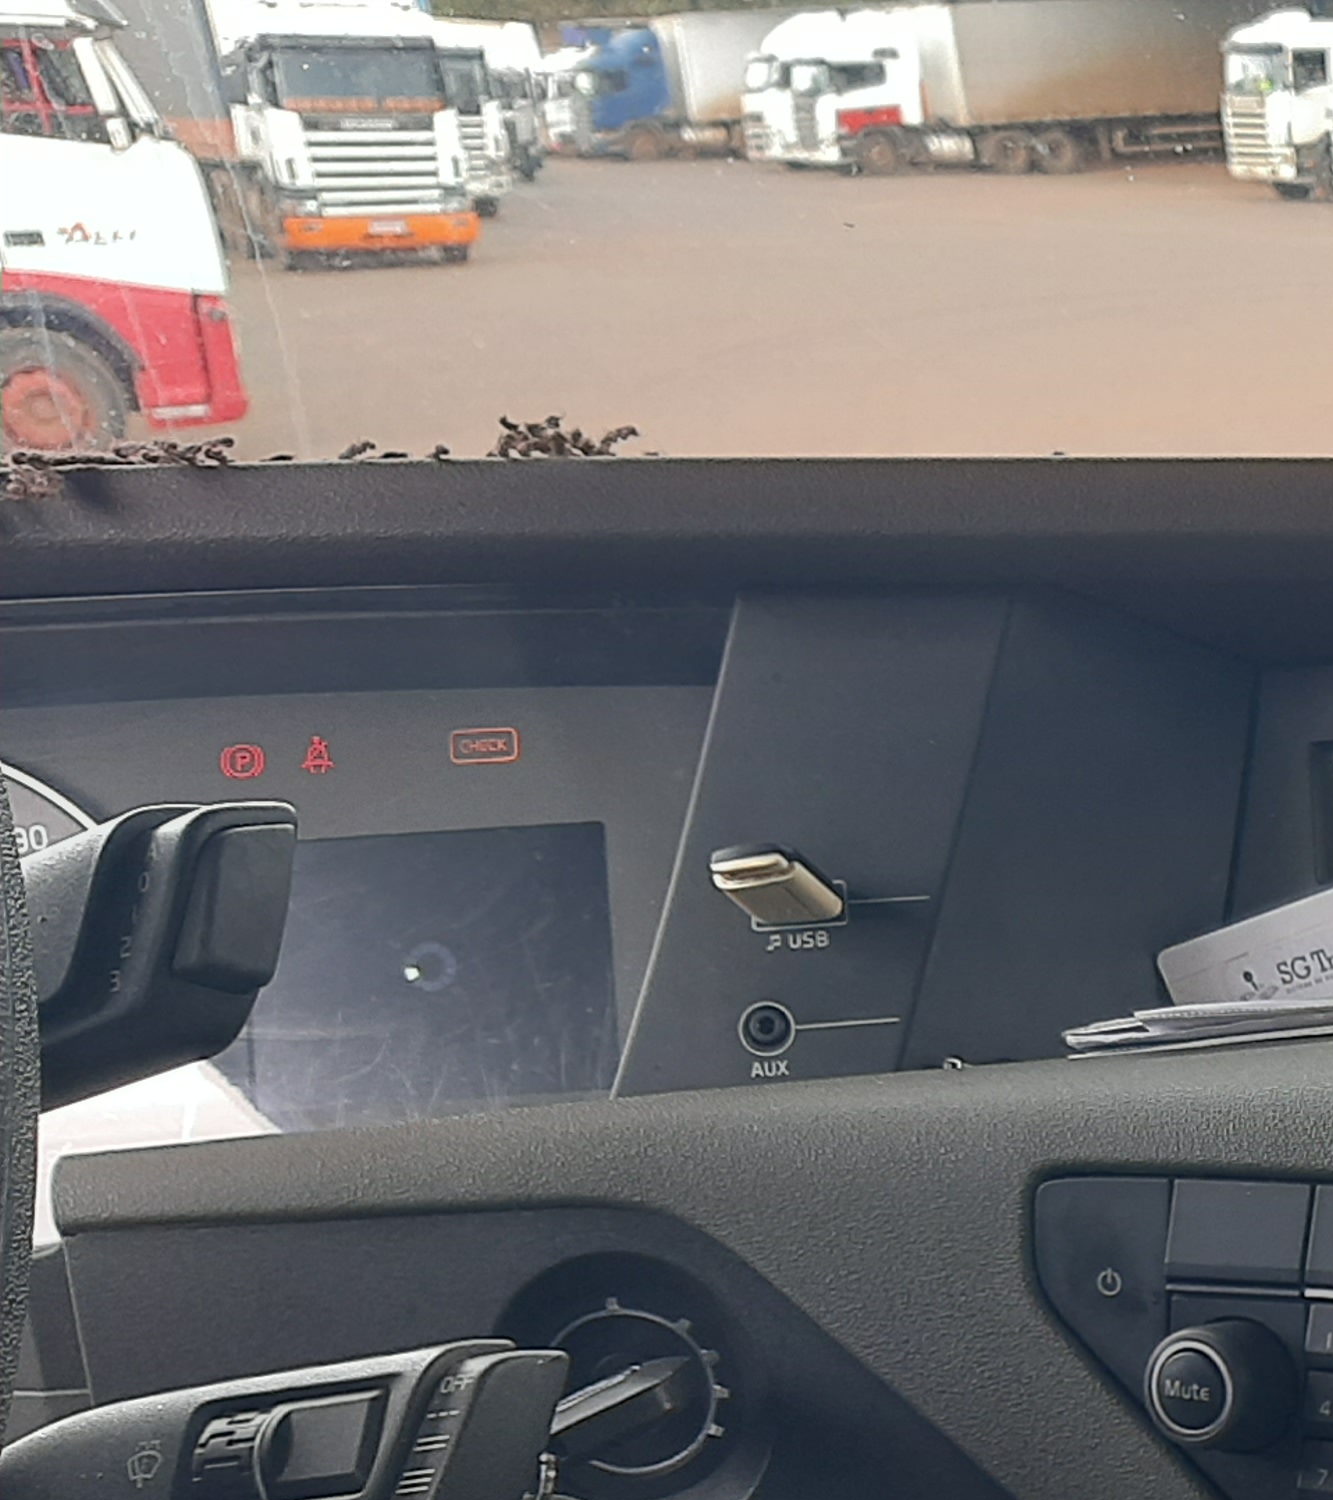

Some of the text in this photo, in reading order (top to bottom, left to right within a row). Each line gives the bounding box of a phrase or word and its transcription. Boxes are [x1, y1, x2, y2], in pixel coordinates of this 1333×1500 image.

[459, 738, 508, 754] CHECK
[787, 930, 830, 949] USB
[1275, 955, 1312, 986] SG
[750, 1059, 790, 1079] AUX
[1163, 1378, 1211, 1402] Mute
[1319, 1399, 1332, 1417] 4
[1316, 1468, 1330, 1487] 7
